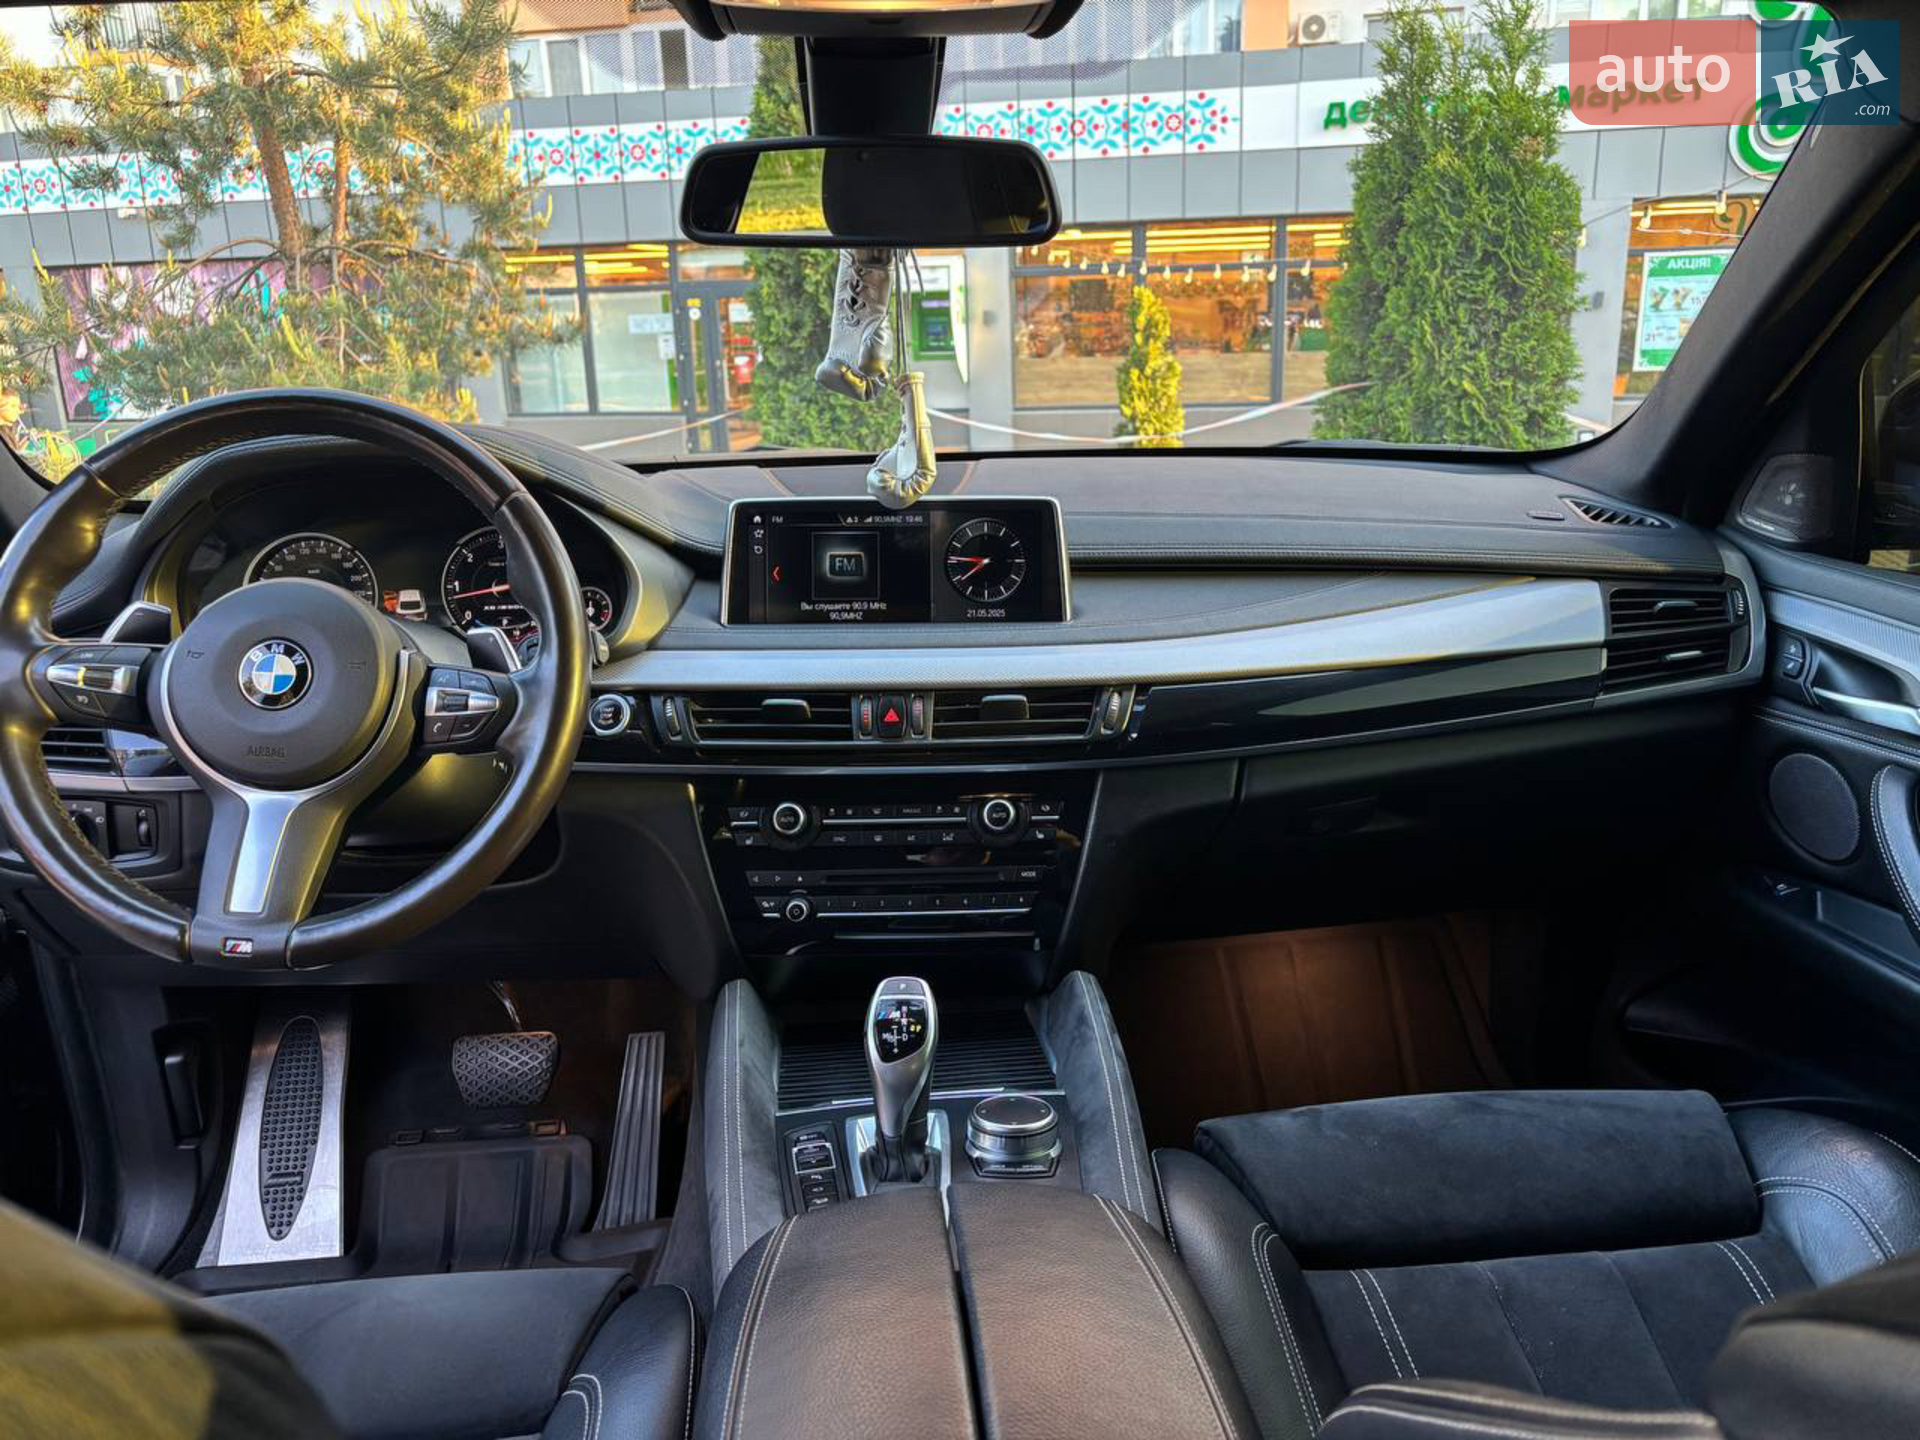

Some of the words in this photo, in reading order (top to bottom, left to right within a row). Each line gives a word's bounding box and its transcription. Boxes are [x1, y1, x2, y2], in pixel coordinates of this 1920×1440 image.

[1558, 78, 1709, 113] маркет
[467, 553, 474, 563] 2
[834, 557, 856, 572] FM
[454, 580, 460, 592] 1
[250, 643, 305, 665] BMW
